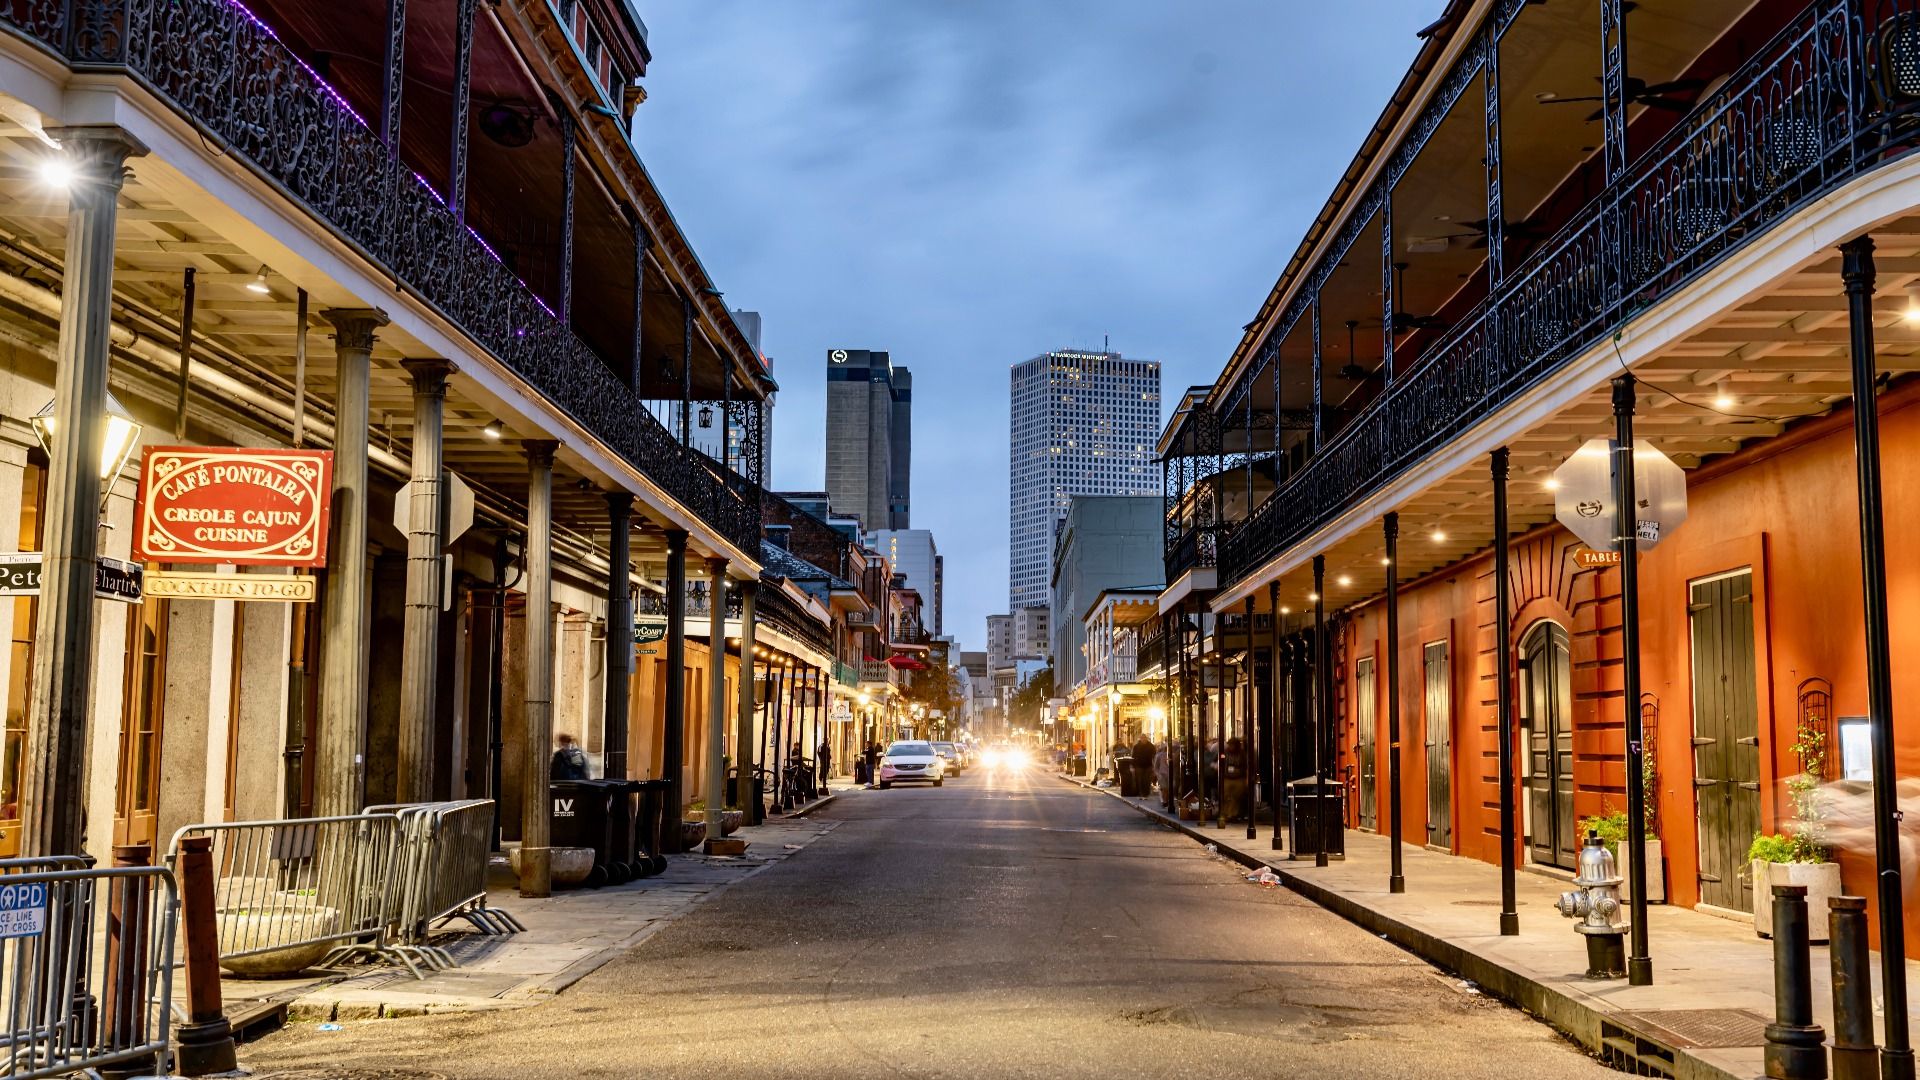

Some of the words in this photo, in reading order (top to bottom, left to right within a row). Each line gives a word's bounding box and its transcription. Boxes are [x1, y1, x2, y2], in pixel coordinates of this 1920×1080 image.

[162, 464, 211, 501] CAFÉ
[213, 465, 306, 506] PONTALBA
[163, 507, 236, 524] CREOLE
[242, 510, 302, 528] CAJUN
[194, 527, 269, 543] CUISINE
[1584, 552, 1622, 563] TABLE
[151, 579, 247, 596] COCKTAILS
[252, 583, 307, 598] TO-GO
[554, 798, 574, 812] IV
[17, 911, 33, 921] LINE
[12, 921, 37, 932] CROSS
